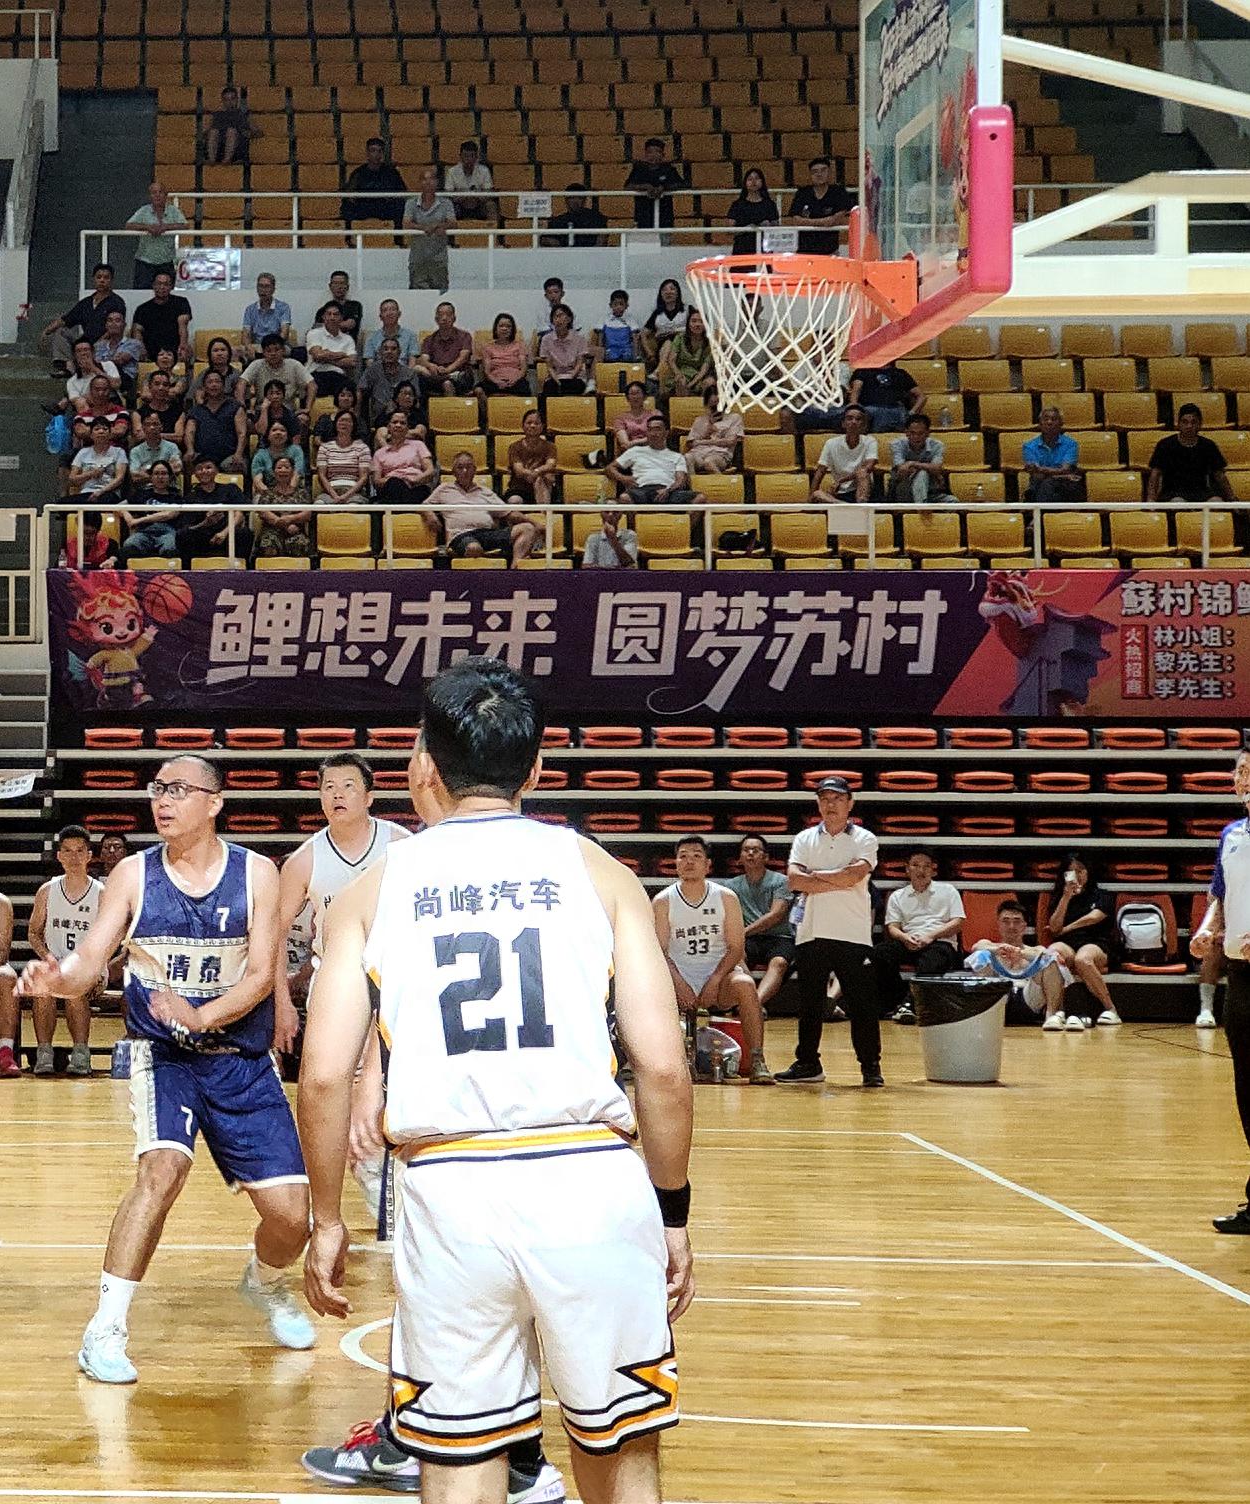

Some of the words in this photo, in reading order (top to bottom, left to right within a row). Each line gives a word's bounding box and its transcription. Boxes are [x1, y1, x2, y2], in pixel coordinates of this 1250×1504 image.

[206, 589, 558, 685] 鲤想未来
[591, 589, 948, 713] 圆梦苏村
[413, 878, 561, 921] 尚峰汽车
[216, 907, 230, 932] 7
[66, 933, 76, 951] 6
[686, 938, 710, 955] 33
[166, 954, 222, 984] 清泰
[433, 927, 555, 1056] 21
[180, 1105, 194, 1136] 7
